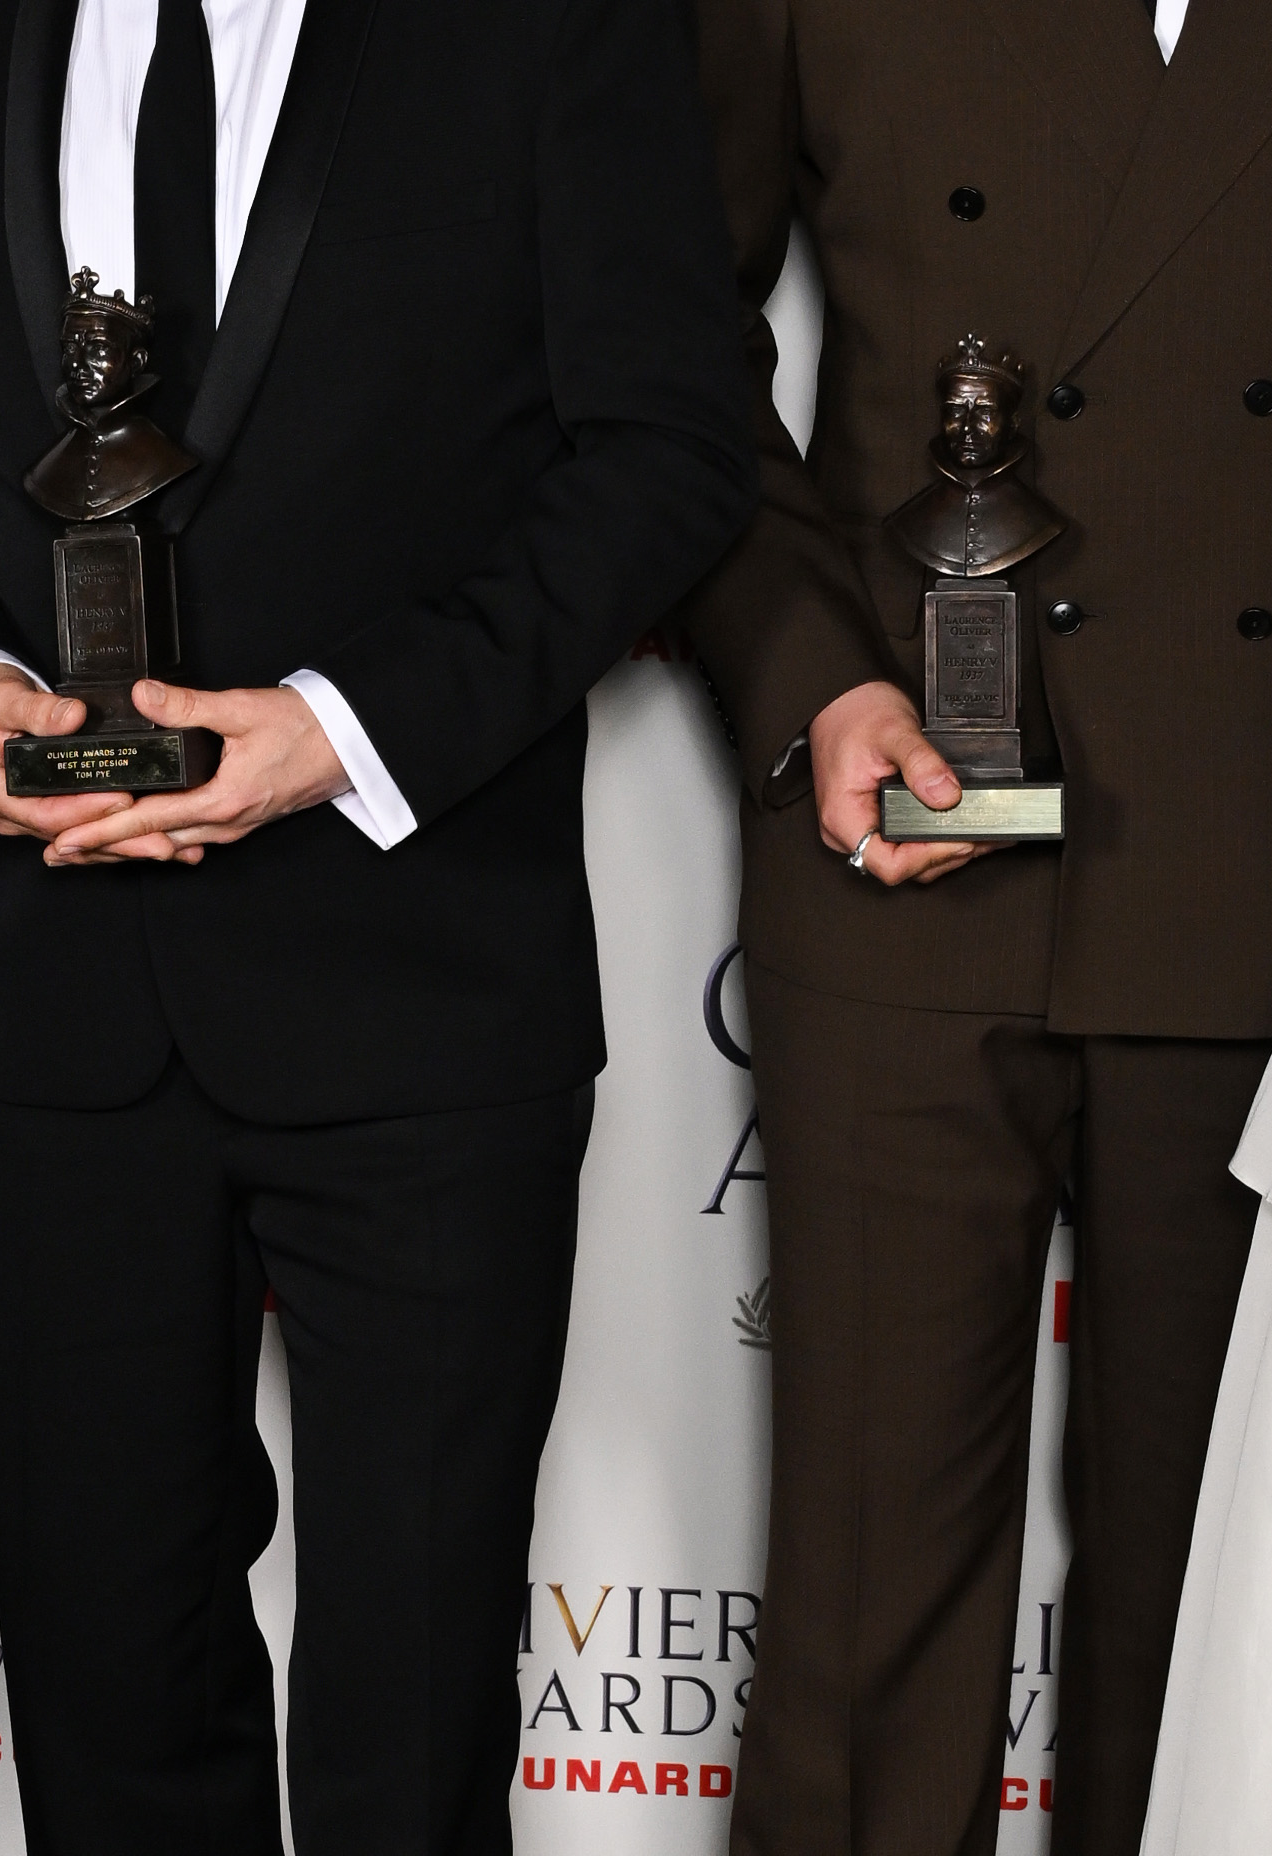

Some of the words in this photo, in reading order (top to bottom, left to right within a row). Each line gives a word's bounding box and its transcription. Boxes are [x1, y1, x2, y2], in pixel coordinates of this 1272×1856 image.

[944, 615, 998, 626] LAURENCE
[950, 626, 992, 636] OLIVIER
[944, 657, 987, 668] HENRY
[959, 670, 985, 681] 1937
[47, 750, 79, 759] OLIVIER
[82, 748, 115, 758] AWARDS
[117, 747, 138, 756] 2026
[57, 761, 78, 770] BEST
[80, 760, 96, 768] SET
[98, 759, 129, 768] DESIGN
[75, 771, 93, 779] TOM
[95, 770, 111, 778] PYE
[518, 1581, 763, 1662] IVIER
[524, 1667, 753, 1739] ARD
[522, 1755, 733, 1799] UNARD
